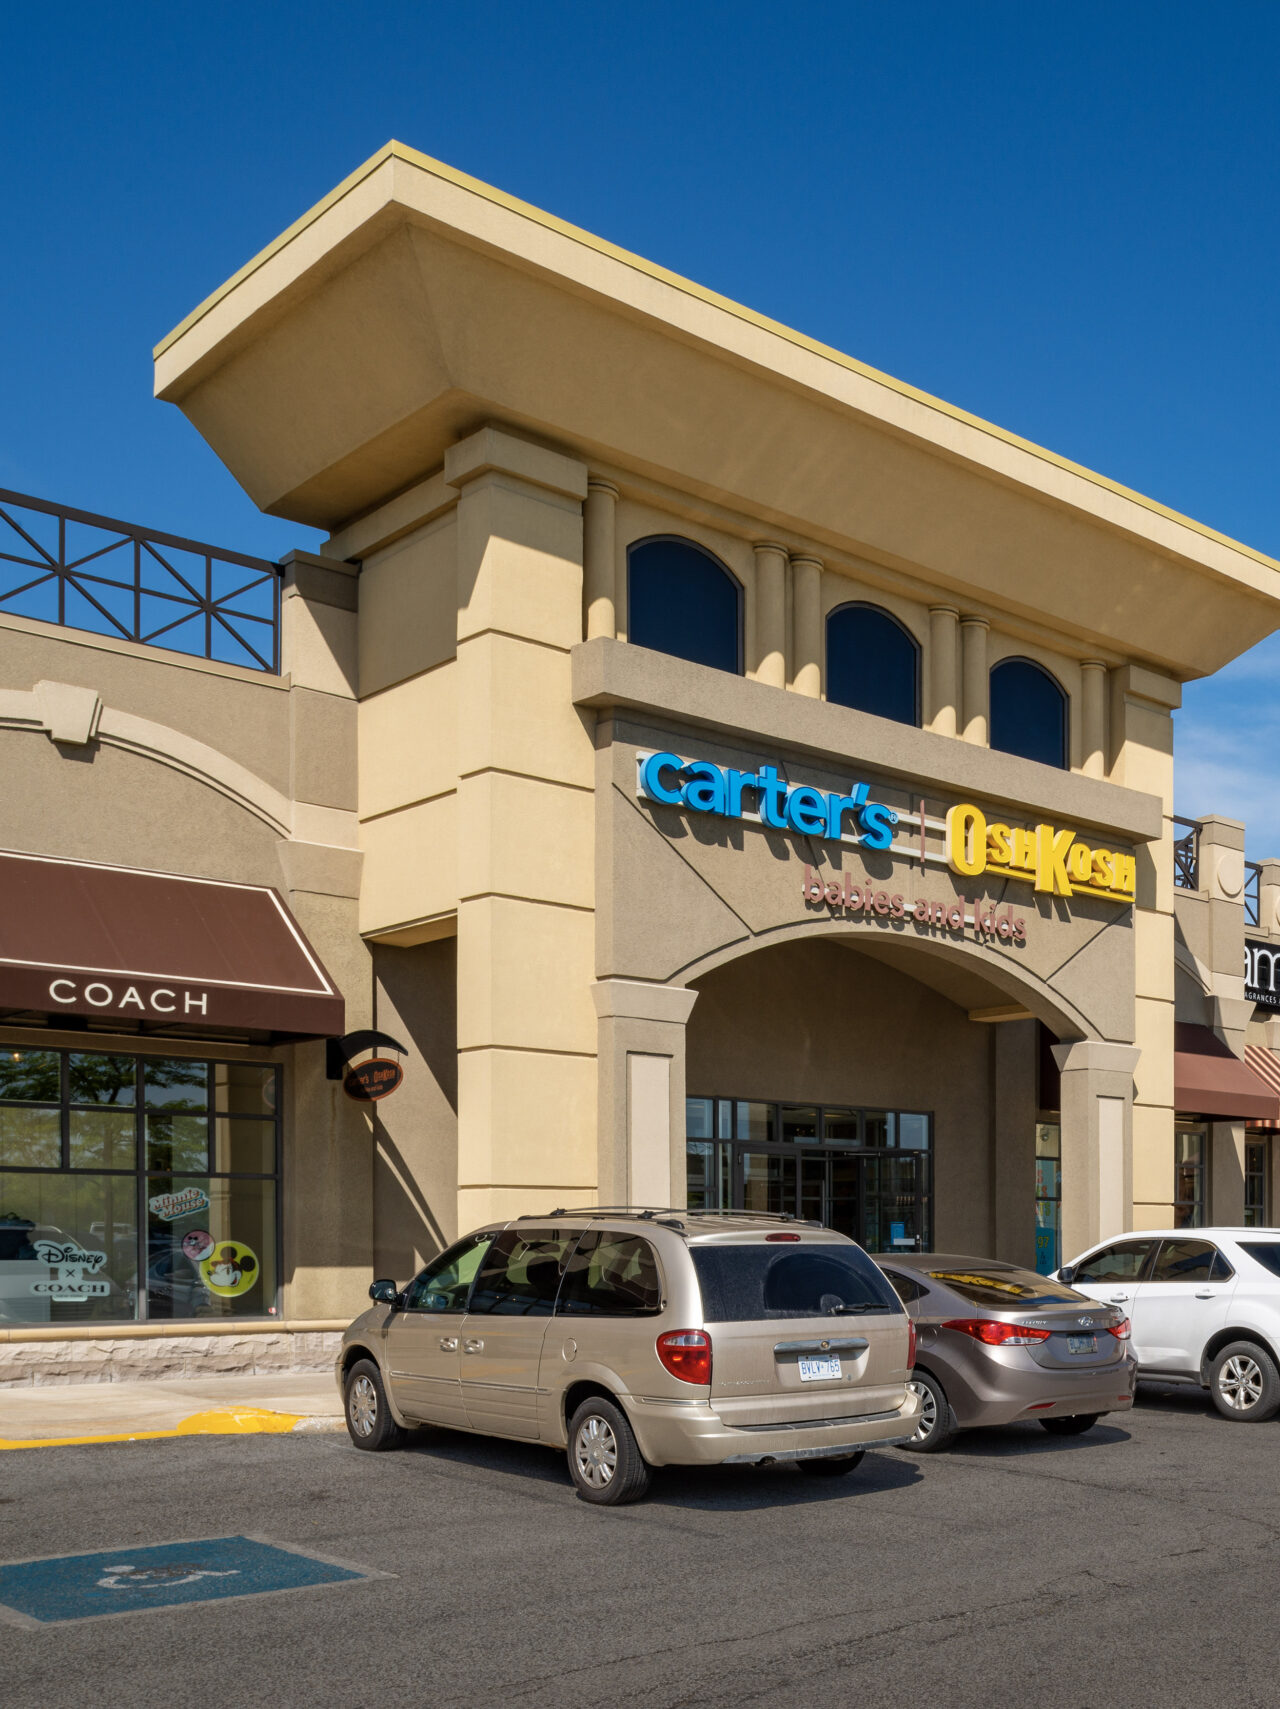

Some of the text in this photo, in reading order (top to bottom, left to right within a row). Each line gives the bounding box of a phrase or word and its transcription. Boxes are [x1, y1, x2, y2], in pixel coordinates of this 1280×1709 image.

[803, 864, 1027, 940] babies and kids
[49, 979, 208, 1015] COACH
[162, 1198, 207, 1219] Mouse
[33, 1283, 105, 1293] COACH
